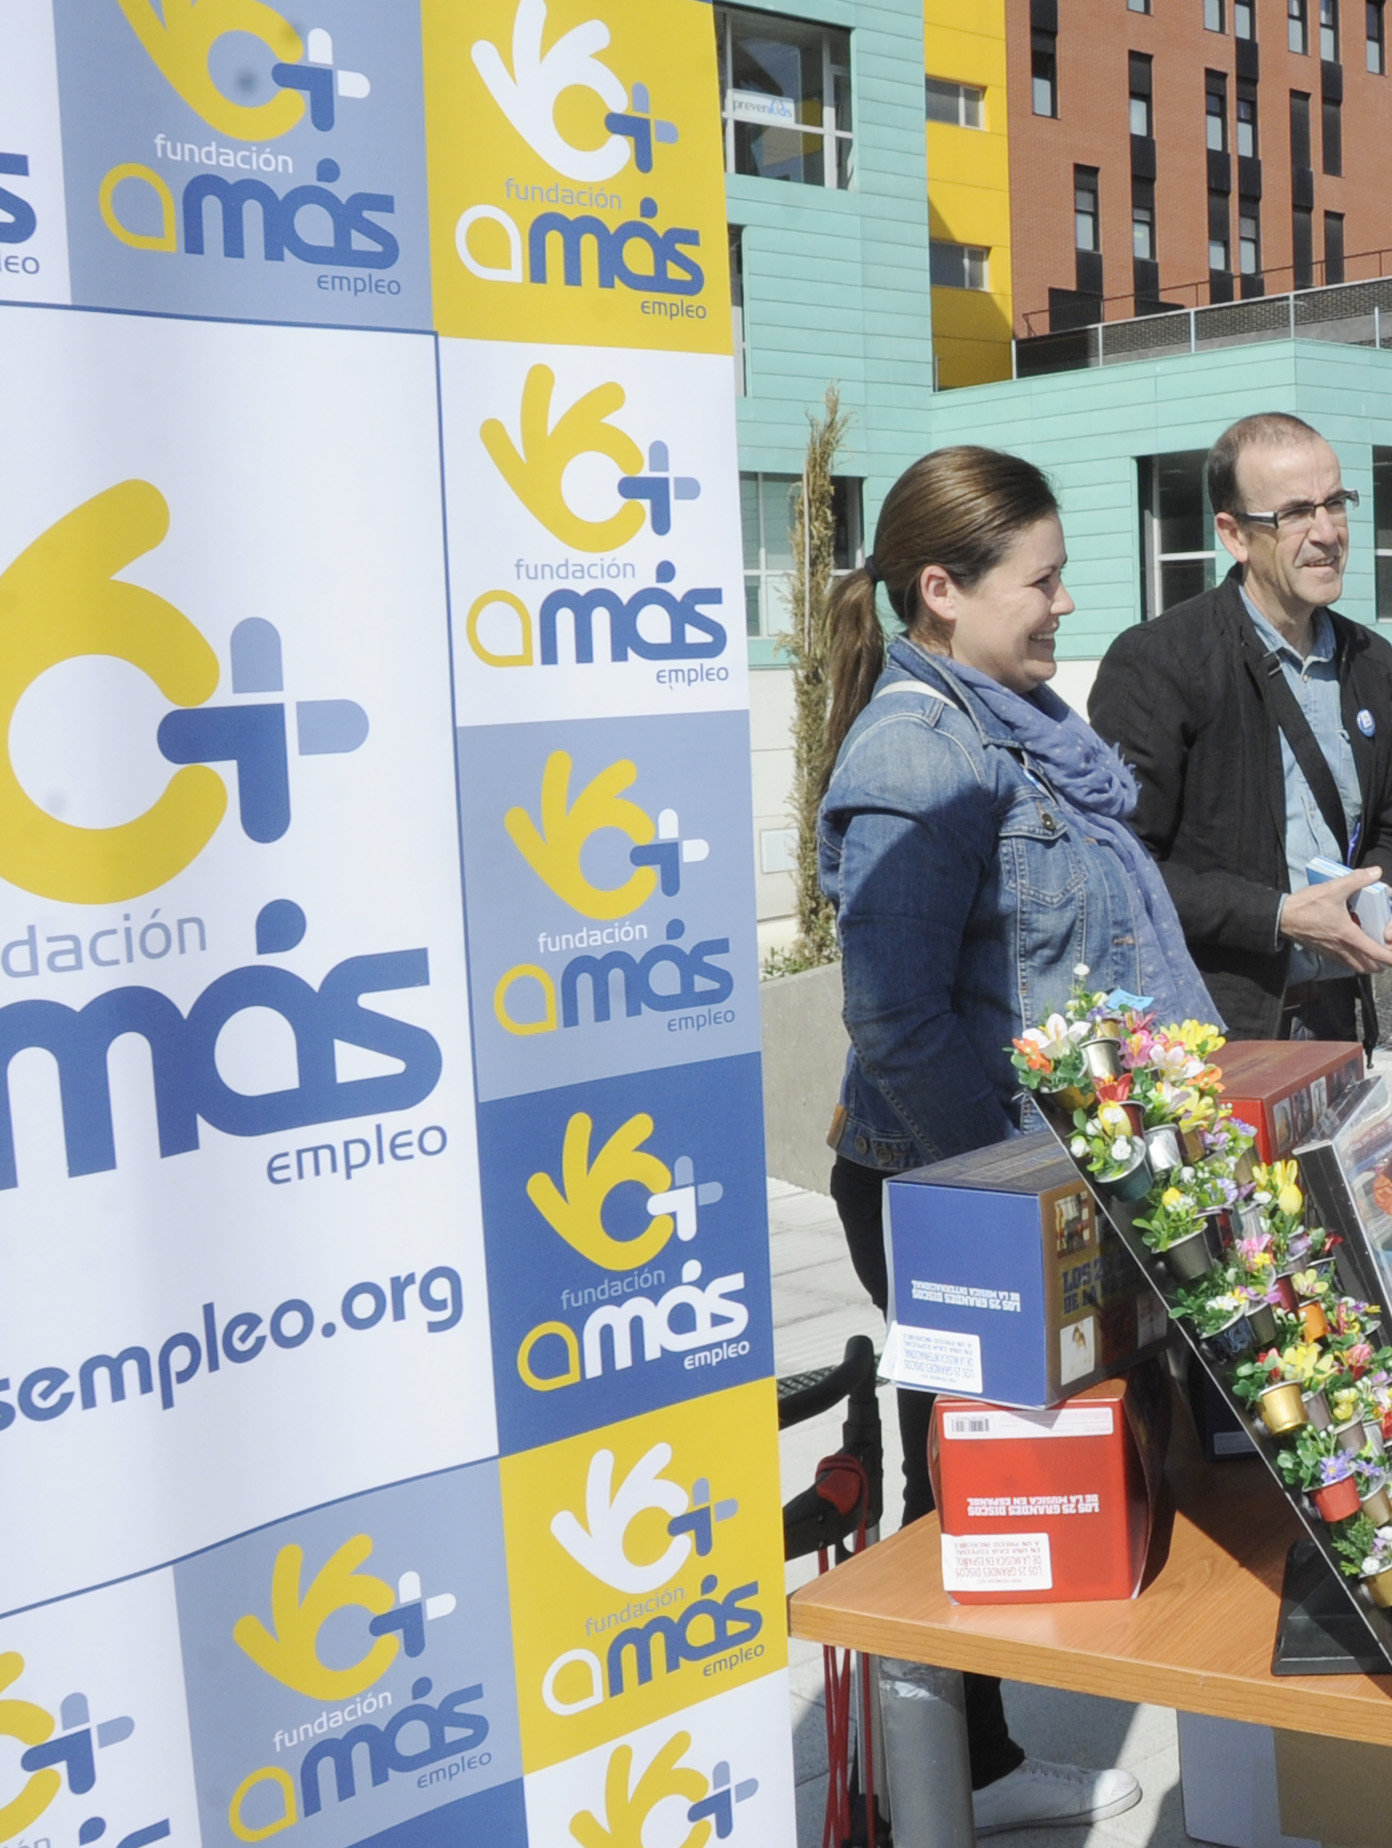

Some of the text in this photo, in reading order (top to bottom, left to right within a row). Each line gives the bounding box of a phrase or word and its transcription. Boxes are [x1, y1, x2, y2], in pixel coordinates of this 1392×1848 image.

[154, 134, 293, 174] fundación
[100, 158, 399, 270] amás
[504, 178, 622, 210] fundación
[455, 197, 705, 296] amás
[317, 272, 400, 297] empleo
[640, 299, 707, 321] empleo
[515, 558, 636, 581] fundación
[467, 560, 727, 667] amás
[655, 663, 729, 686] empleo
[0, 908, 207, 978] dación
[538, 921, 648, 954] fundación
[493, 918, 734, 1036] amás
[667, 1007, 735, 1034] empleo
[0, 899, 443, 1190] más
[267, 1123, 448, 1185] empleo
[561, 1265, 665, 1310] fundación
[945, 1293, 987, 1308] GRANDES
[989, 1299, 1001, 1310] 25
[1003, 1300, 1020, 1312] LOS
[518, 1259, 749, 1392] amás
[683, 1339, 750, 1371] empleo
[968, 1503, 1100, 1516] LOS 25 GRANDES DISCOS
[585, 1583, 685, 1637] fundación
[542, 1575, 763, 1717] amás
[703, 1642, 765, 1678] empleo
[273, 1689, 392, 1752] fundación
[228, 1676, 490, 1843] amás
[416, 1748, 492, 1790] empleo
